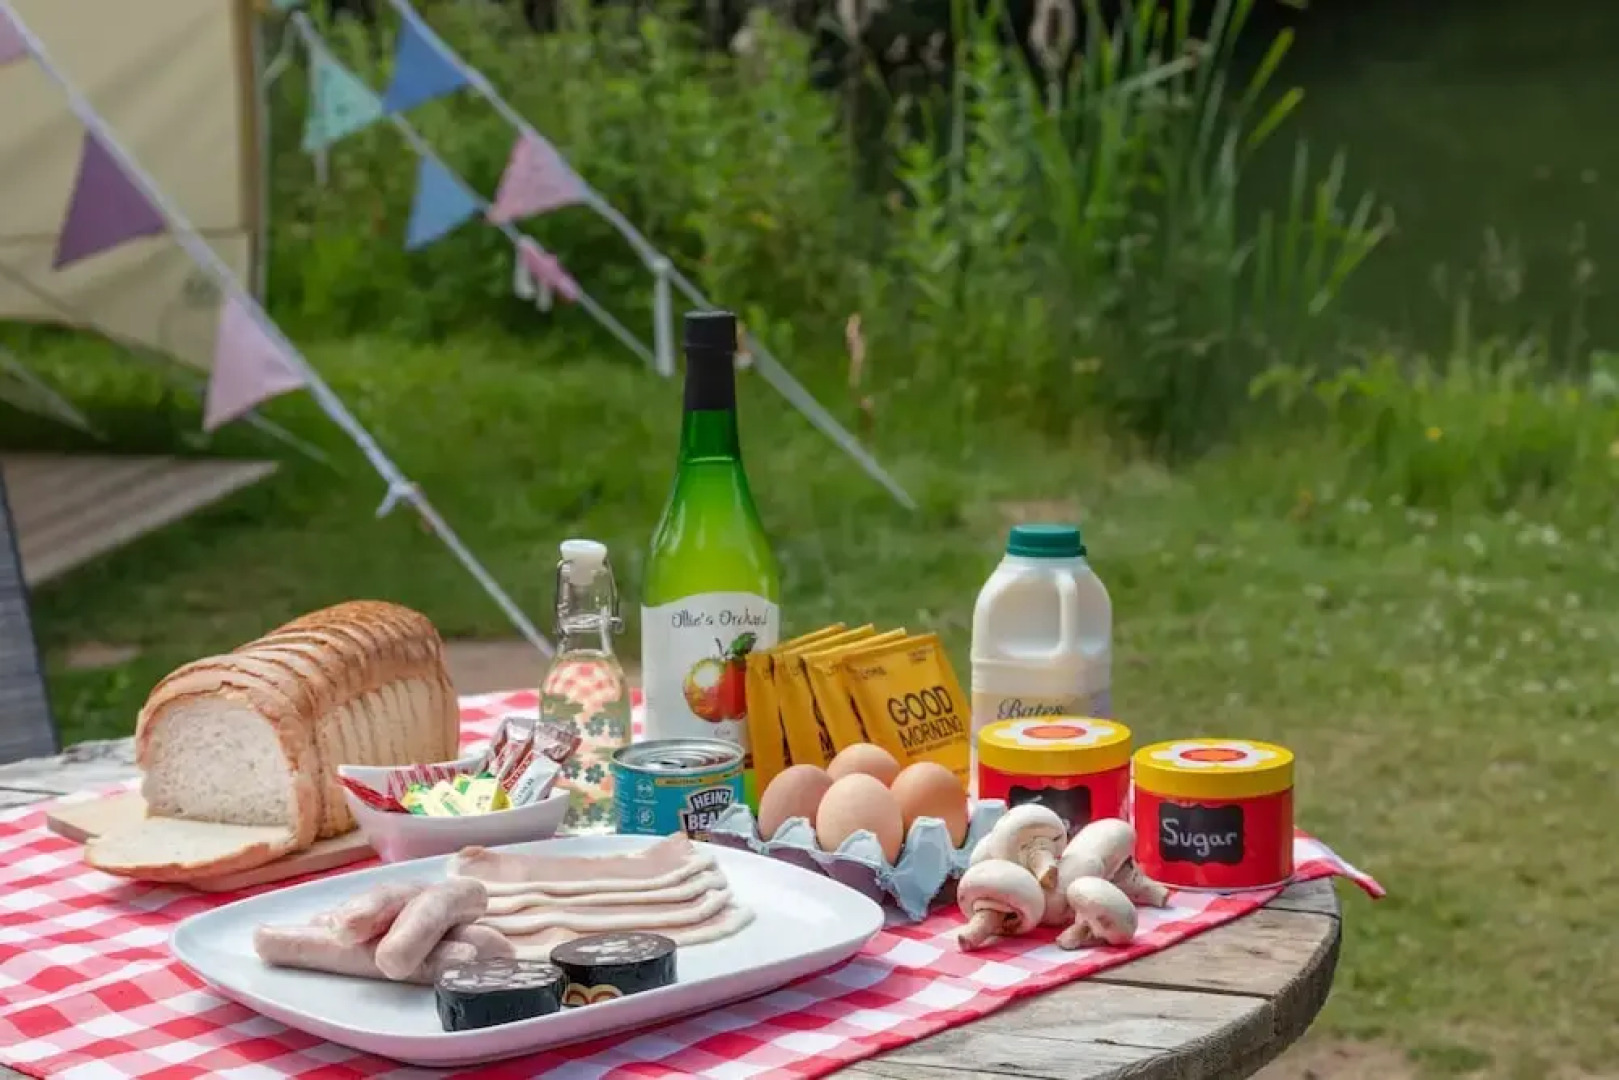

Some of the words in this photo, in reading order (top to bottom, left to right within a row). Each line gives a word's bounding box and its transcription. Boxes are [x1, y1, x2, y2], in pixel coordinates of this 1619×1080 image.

[671, 608, 713, 628] Ollie's
[719, 605, 769, 626] Orchard
[887, 686, 953, 726] GOOD
[898, 715, 963, 748] MORNING
[693, 790, 729, 809] HEINZ
[689, 811, 717, 830] BEA
[1161, 818, 1238, 857] Sugar
